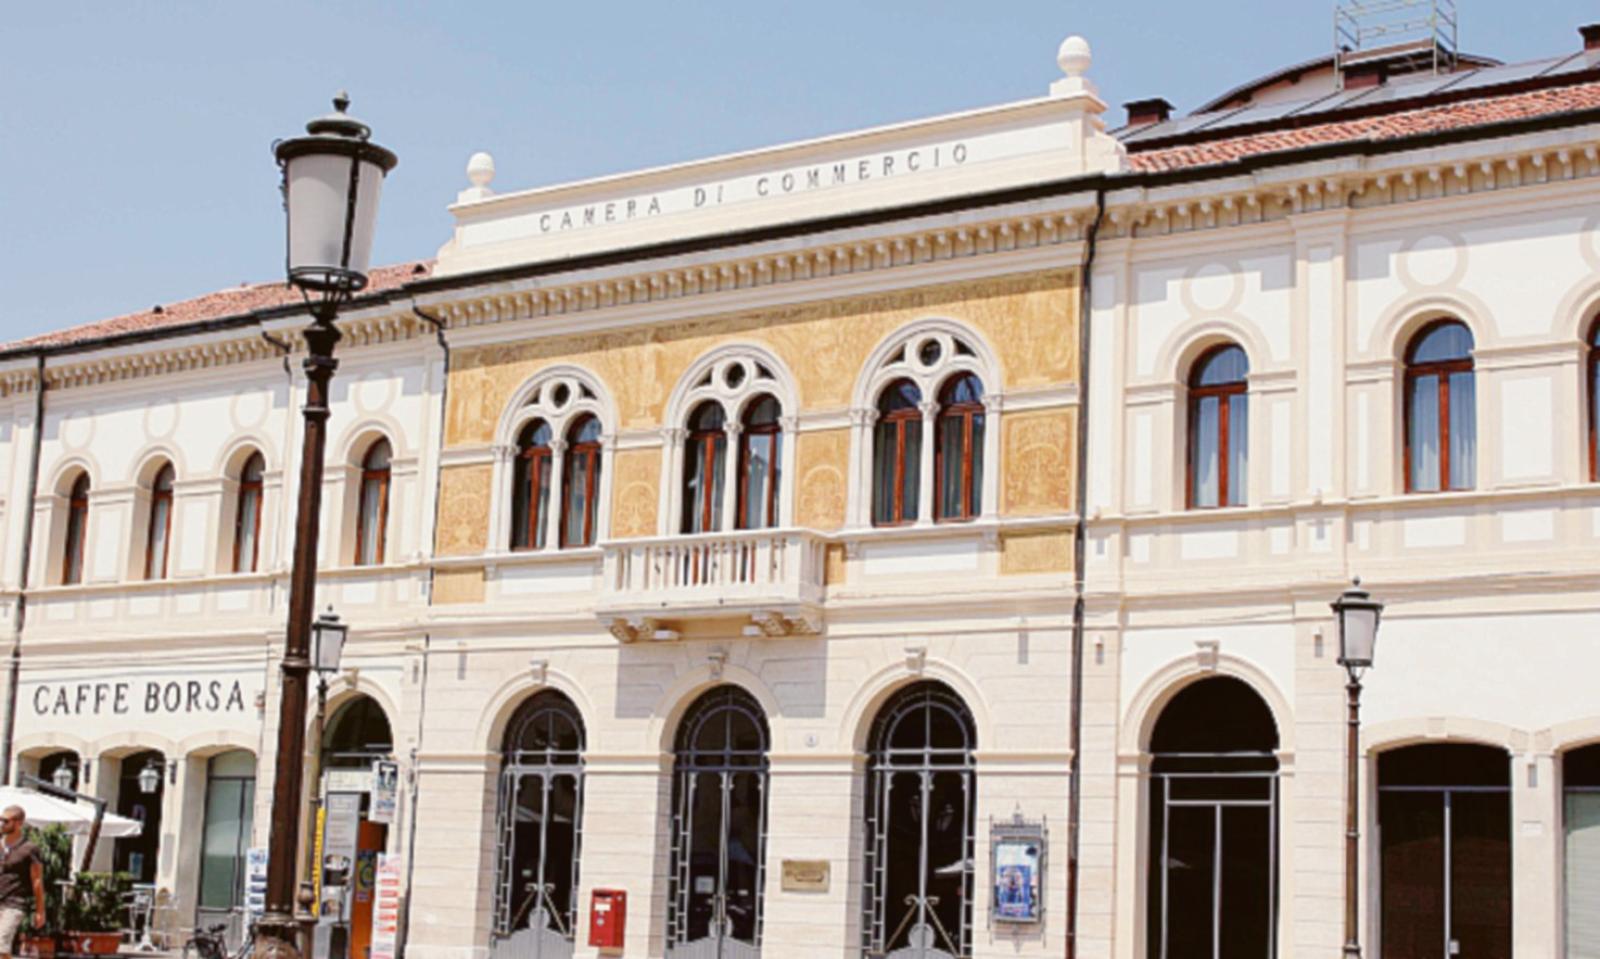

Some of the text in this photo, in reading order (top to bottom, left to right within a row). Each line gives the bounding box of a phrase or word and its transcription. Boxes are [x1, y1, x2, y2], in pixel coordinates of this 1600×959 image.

[539, 144, 967, 233] CAMERA DI COMMERCIO
[33, 678, 244, 716] CAFFE BORSA
